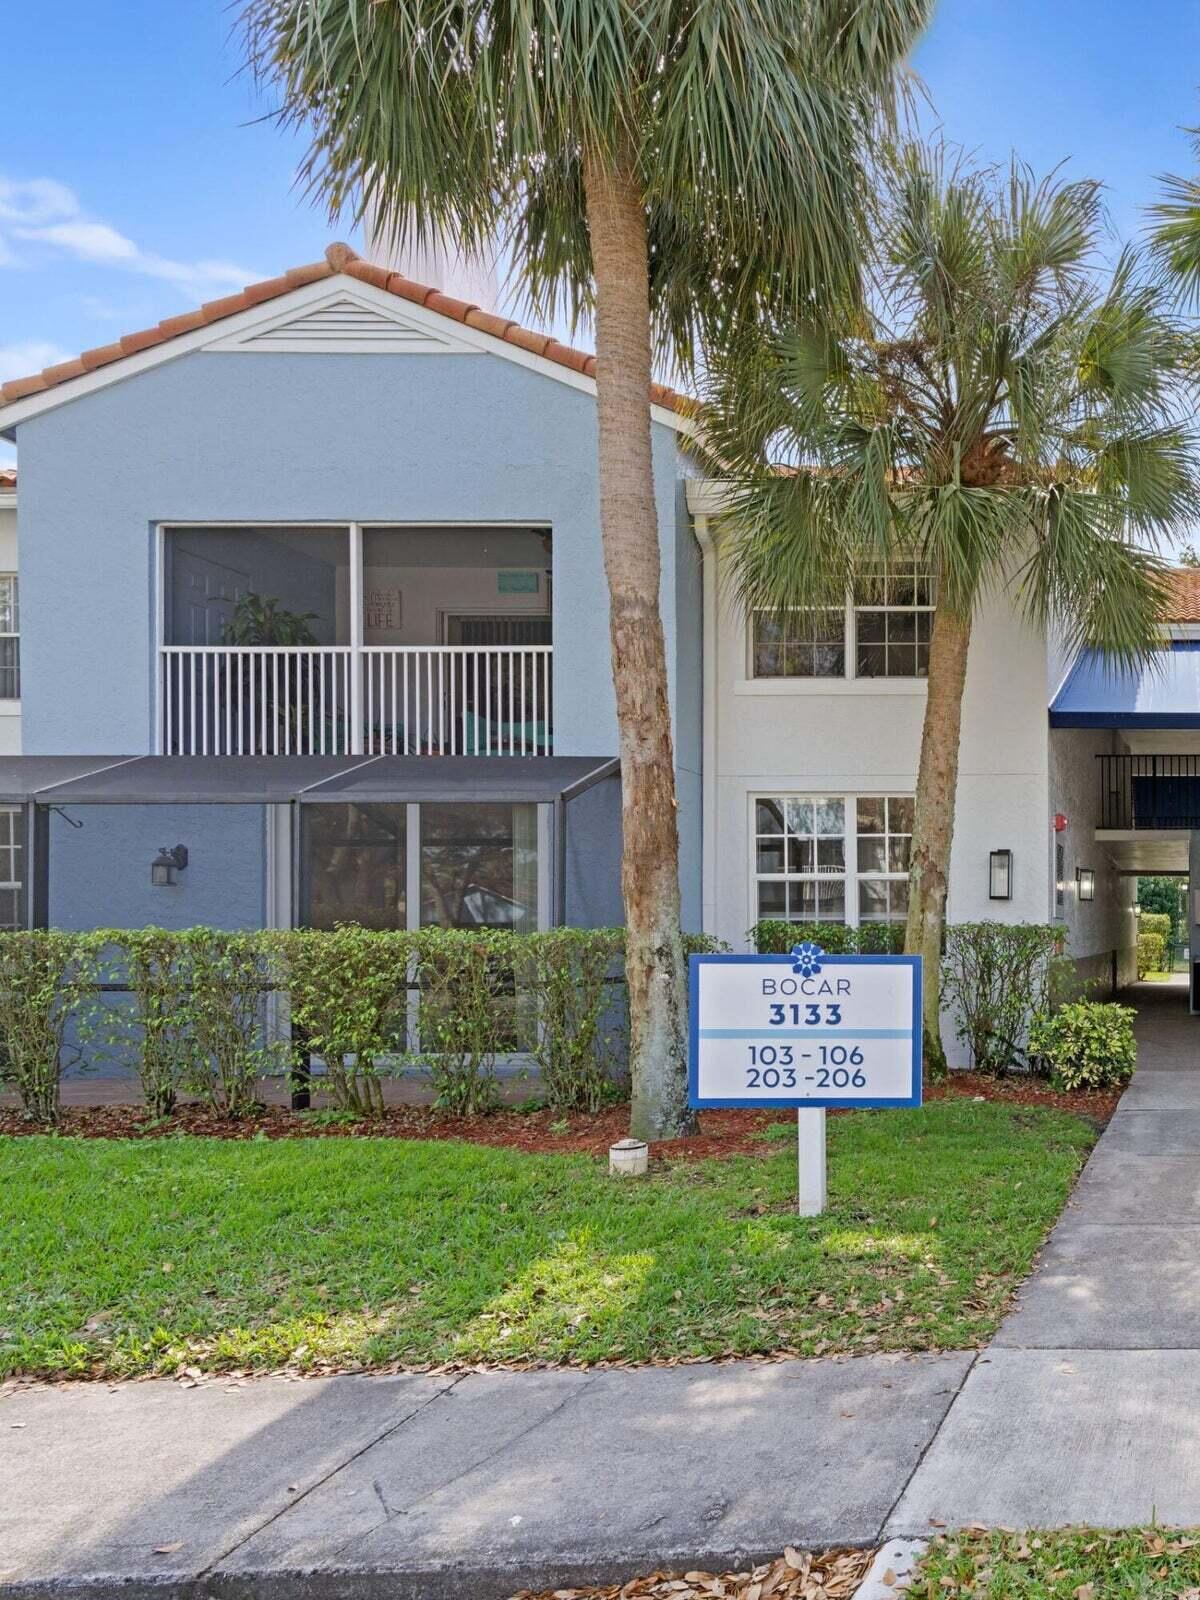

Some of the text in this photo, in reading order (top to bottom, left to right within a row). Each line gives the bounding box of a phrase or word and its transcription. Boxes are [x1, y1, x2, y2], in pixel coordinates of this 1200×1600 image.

[762, 978, 851, 995] BOCAR
[769, 1004, 842, 1025] 3133
[748, 1046, 794, 1065] 103
[819, 1046, 864, 1065] 106
[746, 1068, 797, 1088] 203
